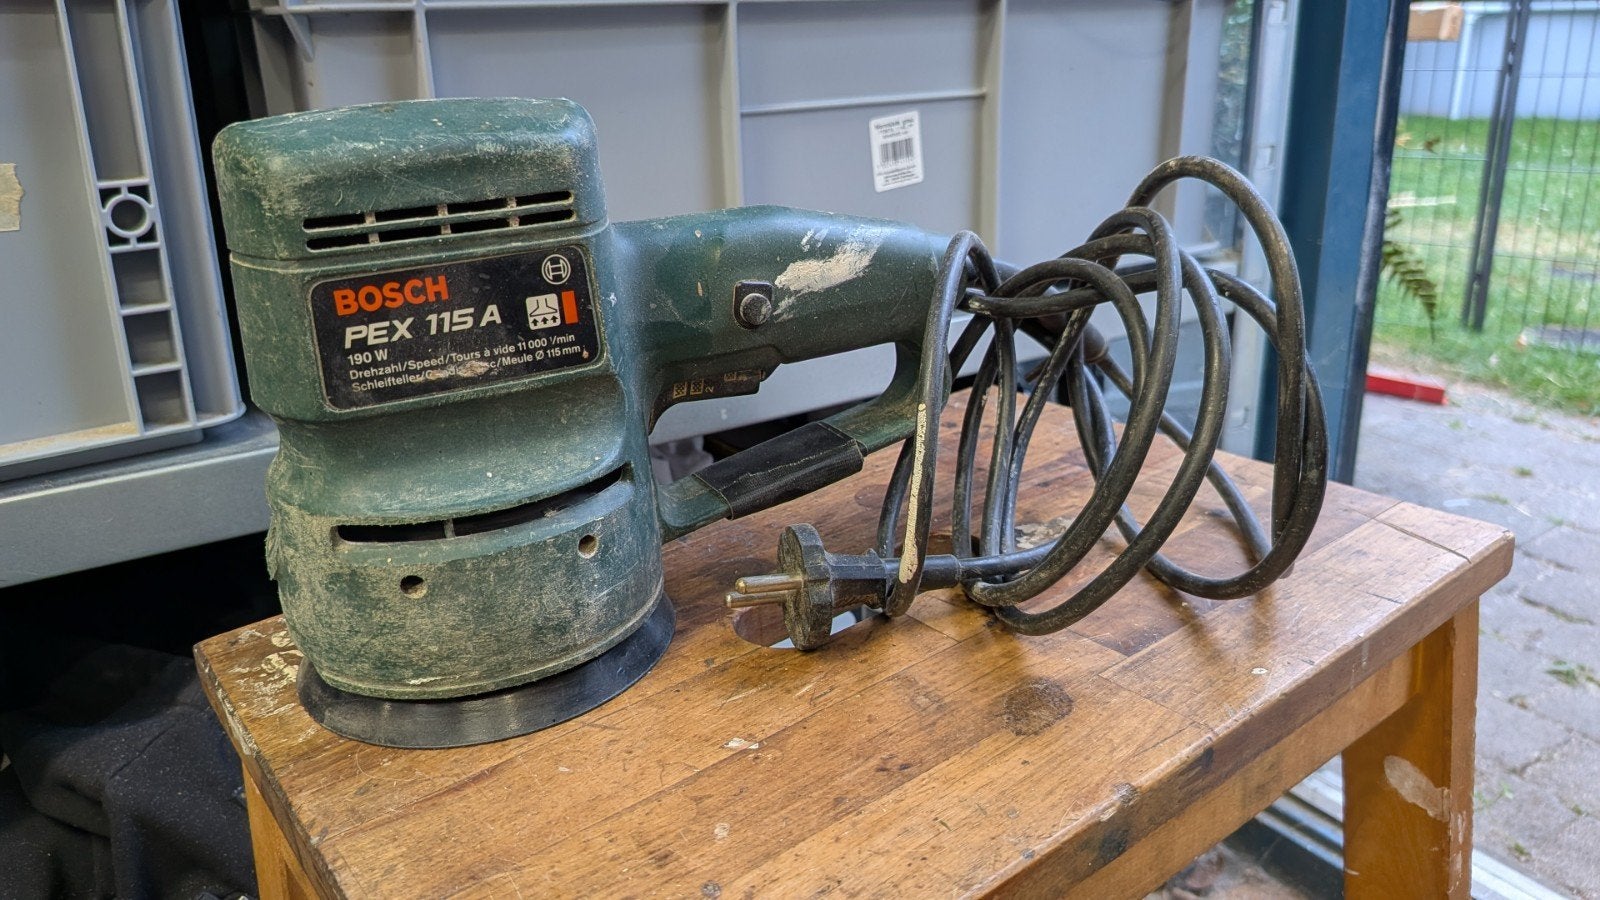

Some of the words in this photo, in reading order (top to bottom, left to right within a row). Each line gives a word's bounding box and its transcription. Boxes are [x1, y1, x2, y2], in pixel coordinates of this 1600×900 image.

[333, 276, 450, 316] BOSCH
[344, 318, 414, 350] PEX
[426, 308, 474, 336] 115
[480, 304, 502, 328] A
[348, 352, 372, 366] 190
[374, 348, 388, 362] W
[349, 351, 481, 380] Drehzahl/Speed/Tours
[484, 348, 490, 357] à
[493, 344, 516, 355] vide
[546, 348, 561, 358] 115
[562, 345, 581, 354] mm
